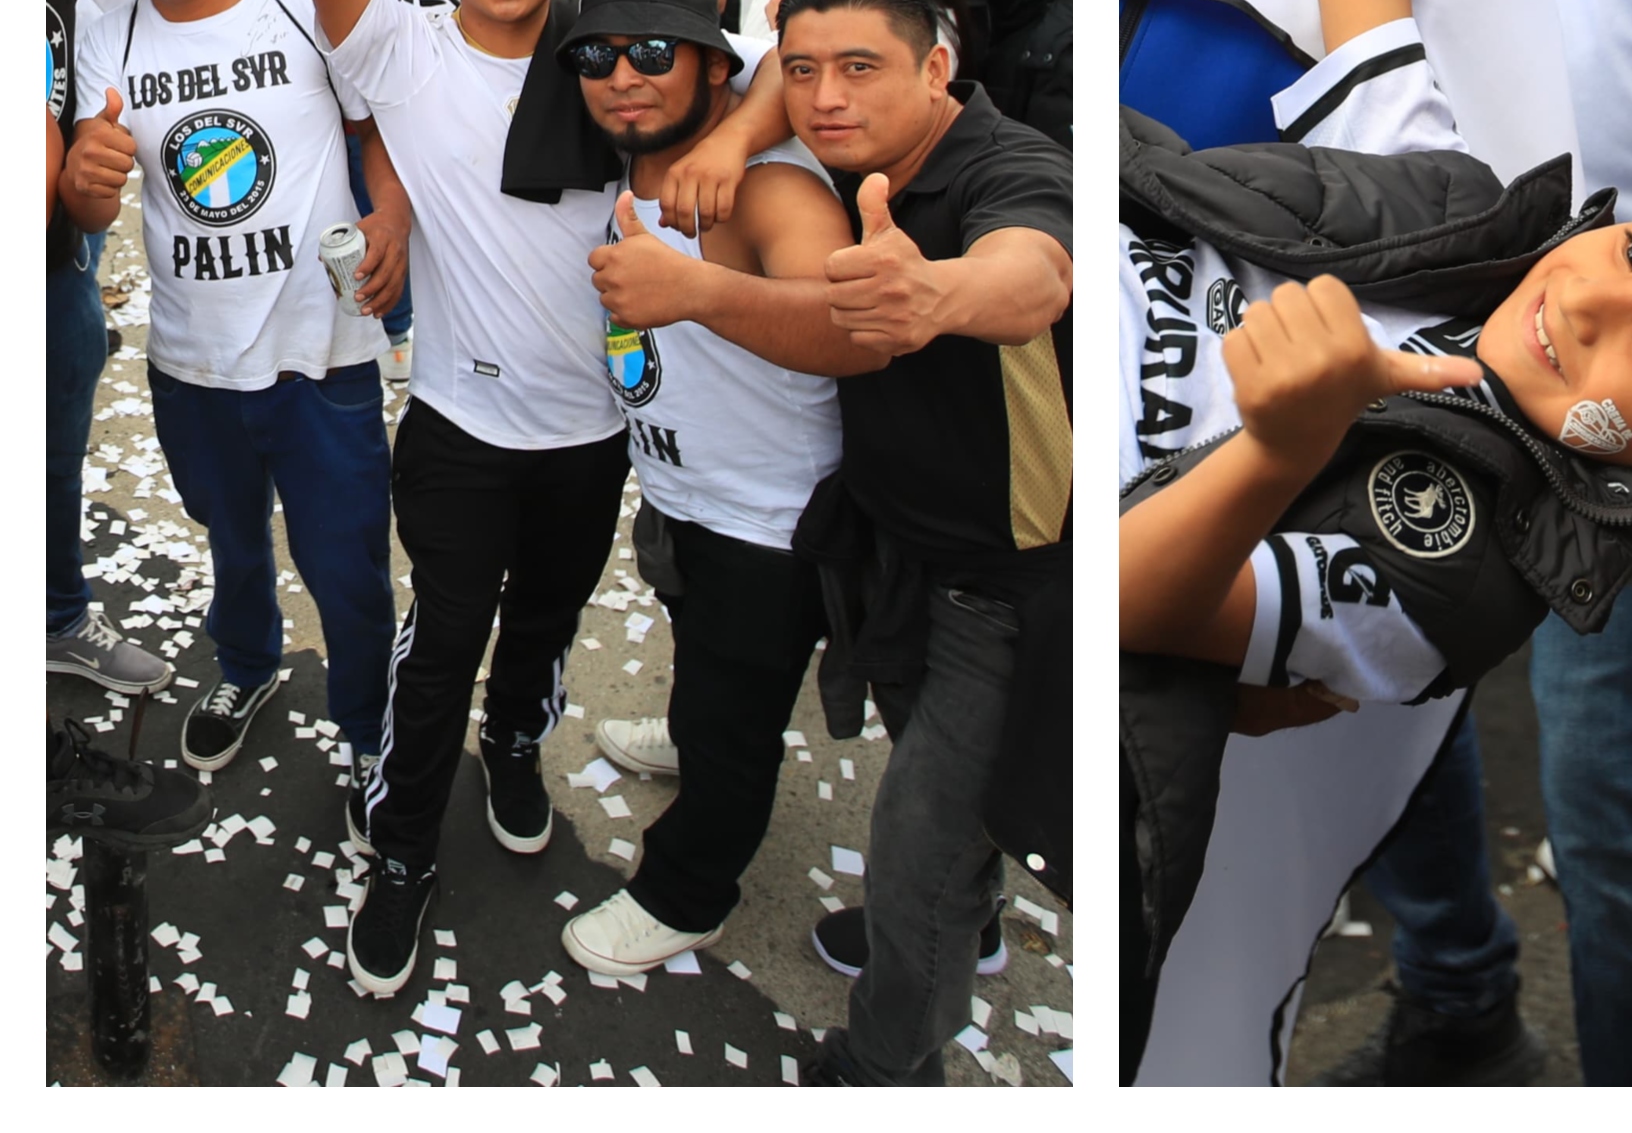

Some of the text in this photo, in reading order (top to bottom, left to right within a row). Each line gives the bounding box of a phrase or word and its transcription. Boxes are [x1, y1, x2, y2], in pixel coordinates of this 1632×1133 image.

[128, 71, 174, 110] LOS
[177, 63, 228, 103] DEL
[169, 126, 192, 151] LOS
[194, 116, 222, 129] DEL
[188, 138, 250, 194] COMUNICACIONES
[179, 180, 265, 219] 23 DE MAYO DEL 2015
[172, 224, 294, 281] PALIN
[634, 380, 650, 399] 2015
[1374, 457, 1468, 551] abercrombie and fitch
